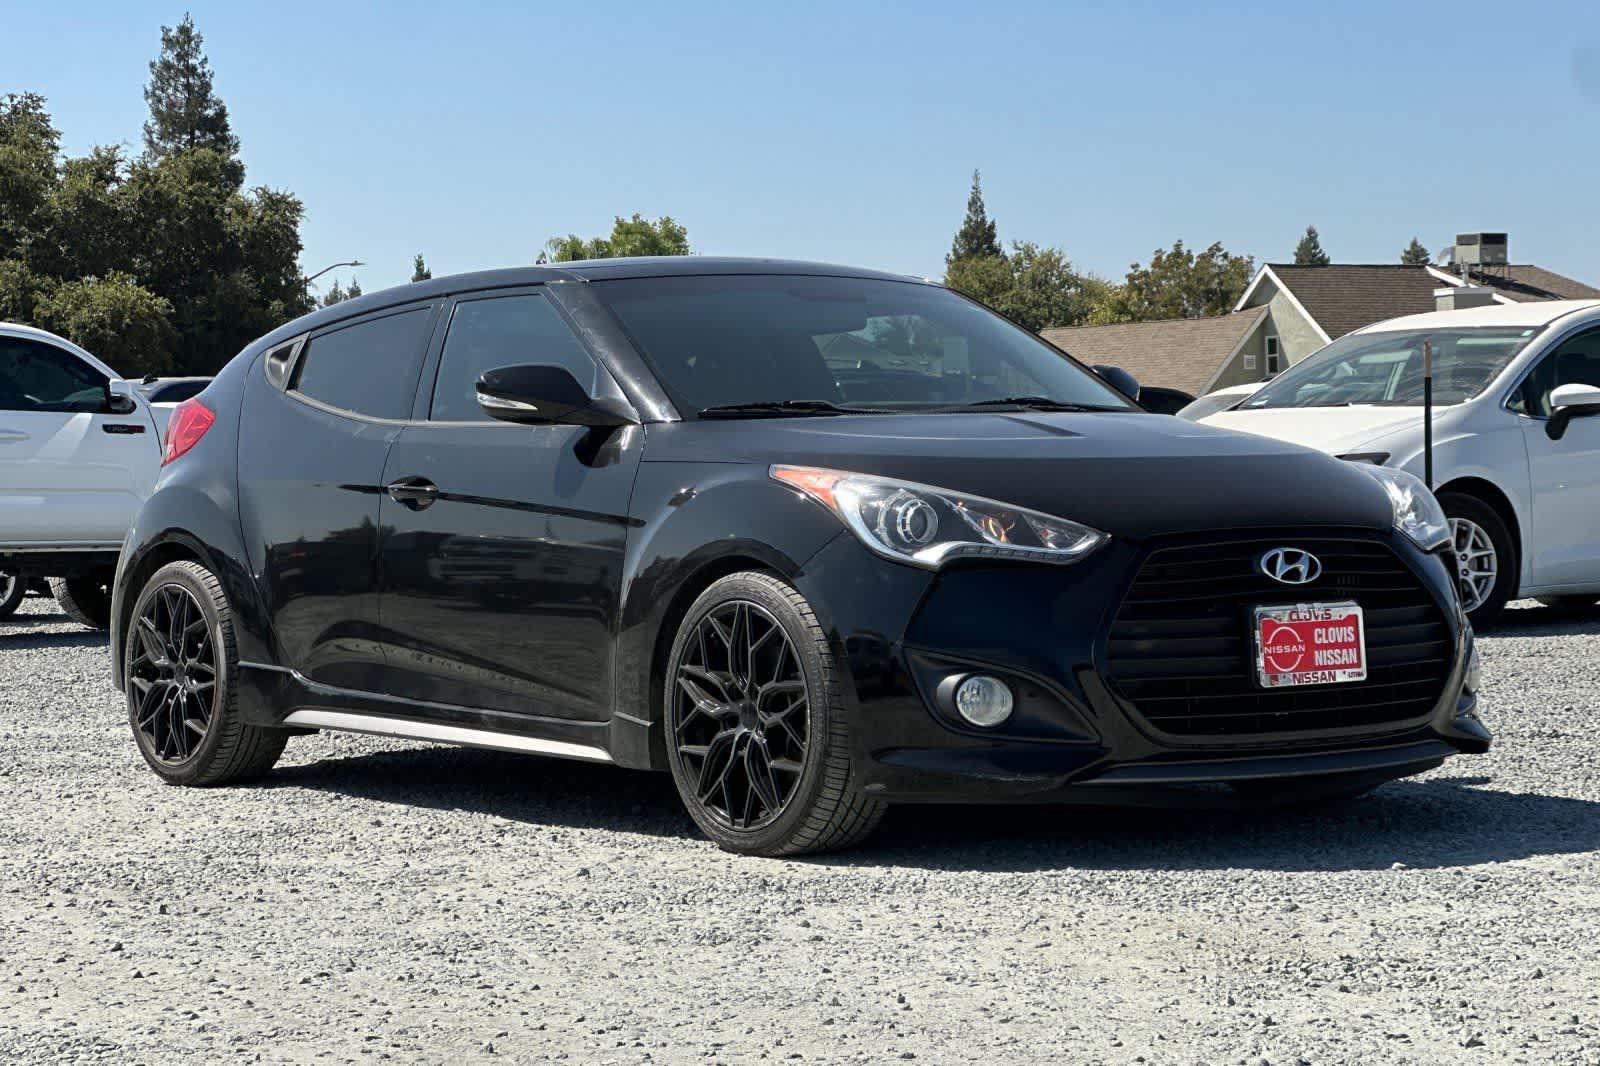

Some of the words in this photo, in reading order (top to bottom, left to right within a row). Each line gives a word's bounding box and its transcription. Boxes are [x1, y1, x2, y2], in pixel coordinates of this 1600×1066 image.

[1314, 626, 1355, 644] CLOVIS
[1264, 645, 1305, 654] NISSAN
[1314, 648, 1358, 666] NISSAN
[1292, 671, 1337, 684] NISSAN
